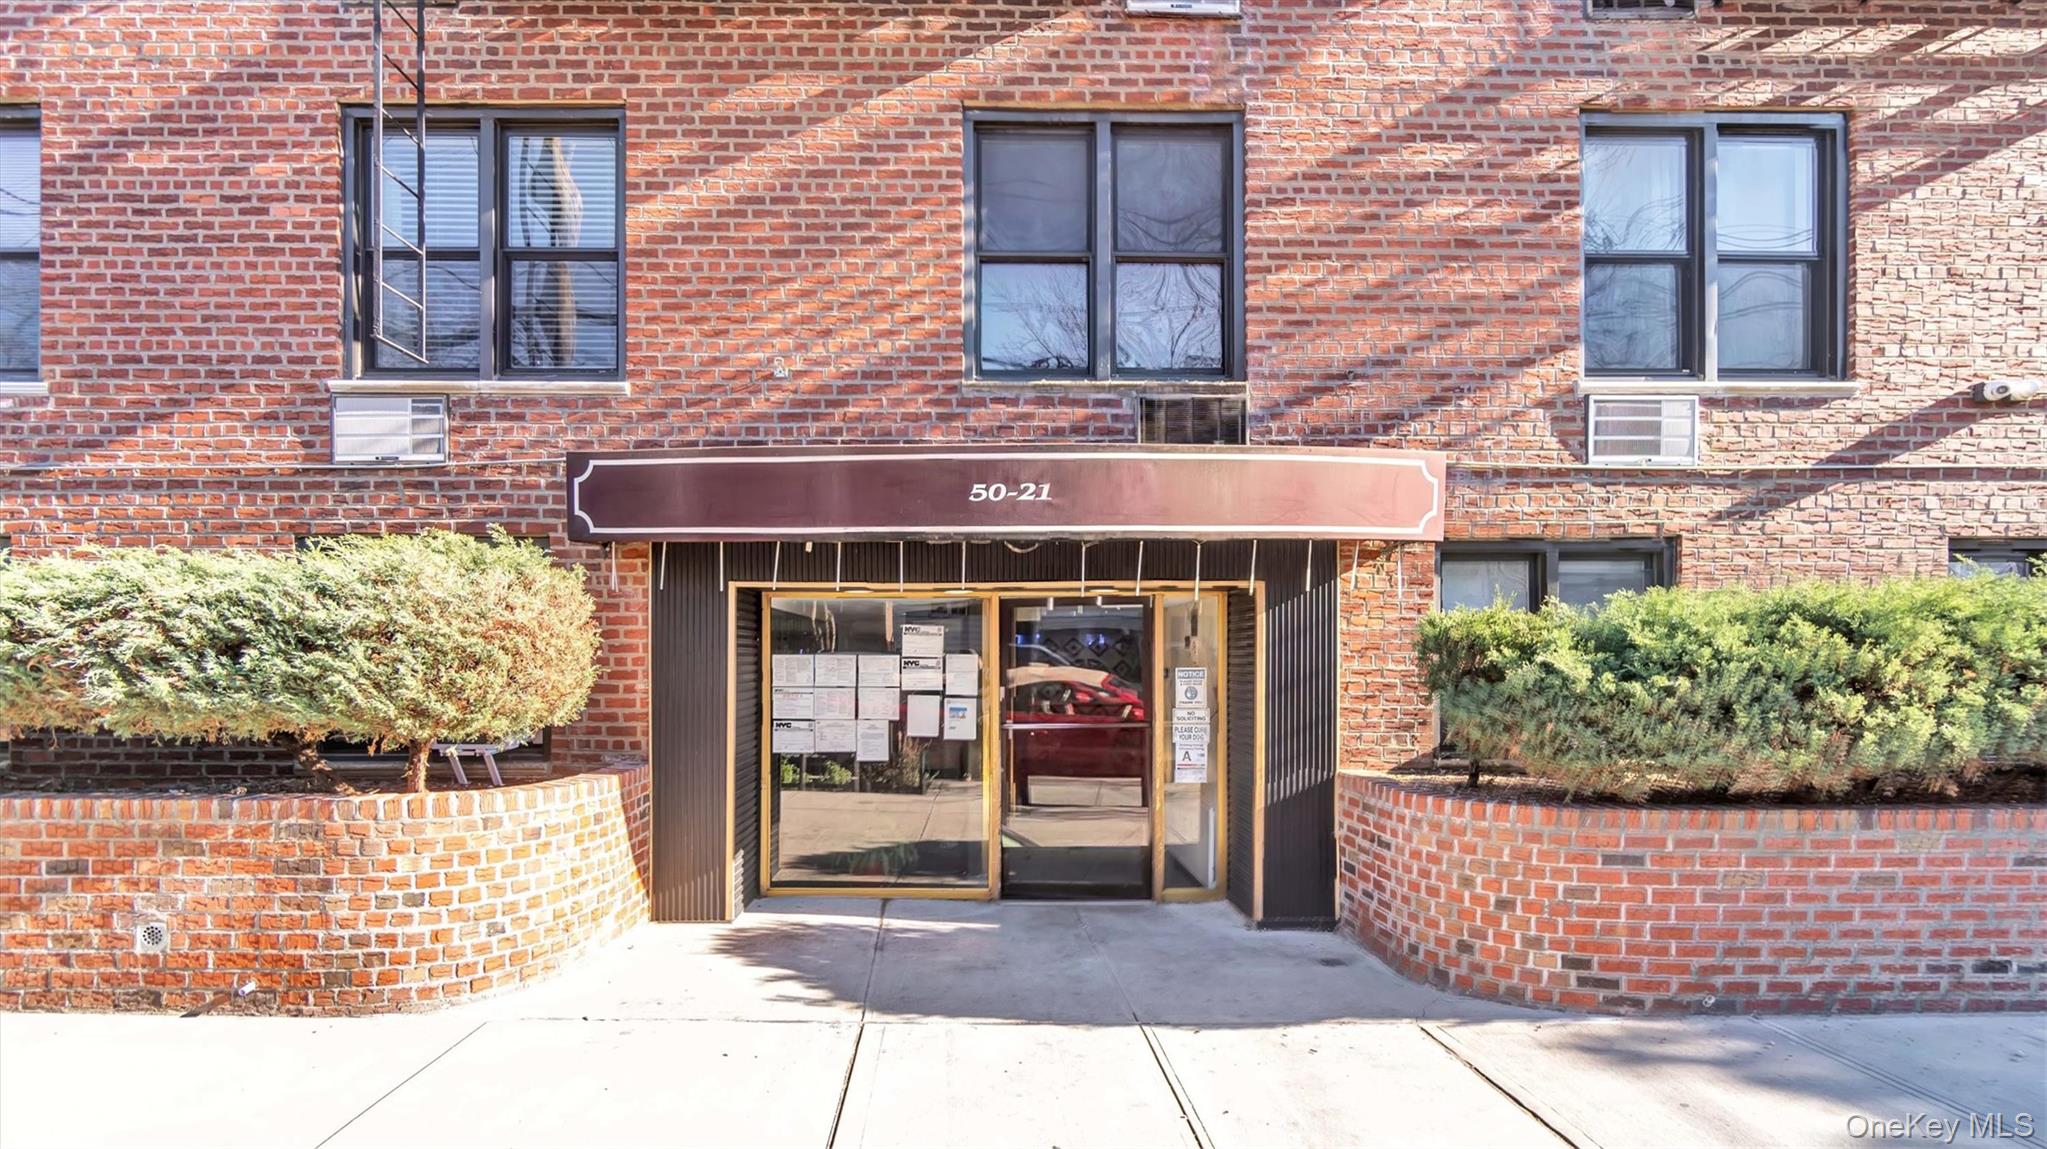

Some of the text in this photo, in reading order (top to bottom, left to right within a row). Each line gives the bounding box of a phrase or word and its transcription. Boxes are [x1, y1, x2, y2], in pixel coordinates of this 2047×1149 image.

[968, 482, 1053, 502] 50-21
[1178, 670, 1204, 678] NOTICE
[1175, 726, 1193, 734] PLEASE
[1182, 751, 1191, 761] A
